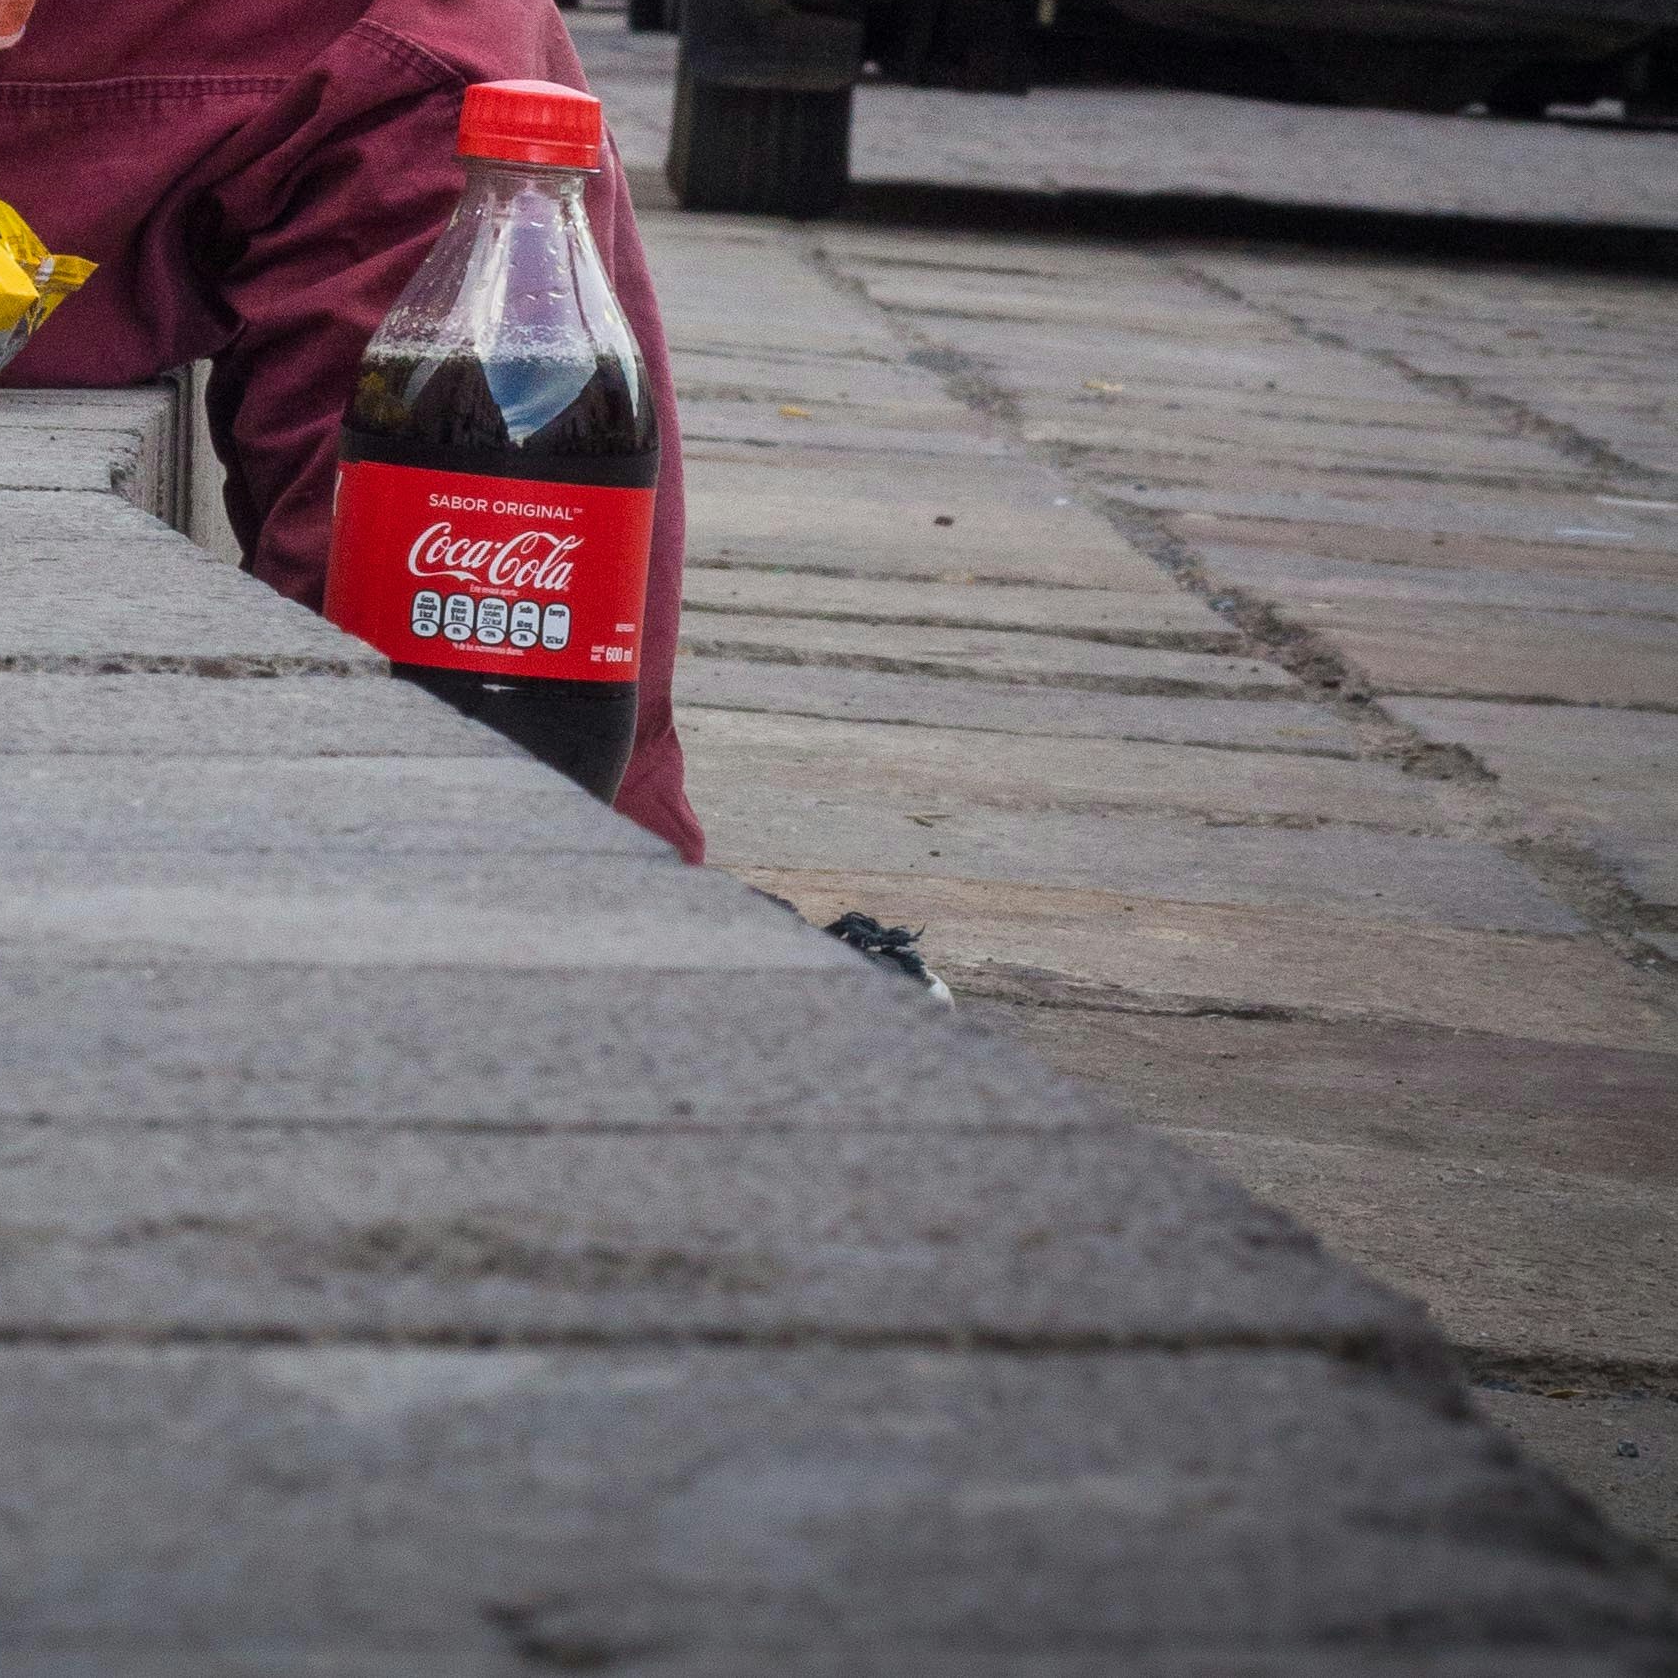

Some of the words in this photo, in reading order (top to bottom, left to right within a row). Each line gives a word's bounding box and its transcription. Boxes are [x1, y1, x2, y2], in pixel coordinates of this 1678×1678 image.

[429, 493, 488, 513] SABOR
[408, 521, 585, 591] Coca-Cola
[605, 646, 624, 663] 600
